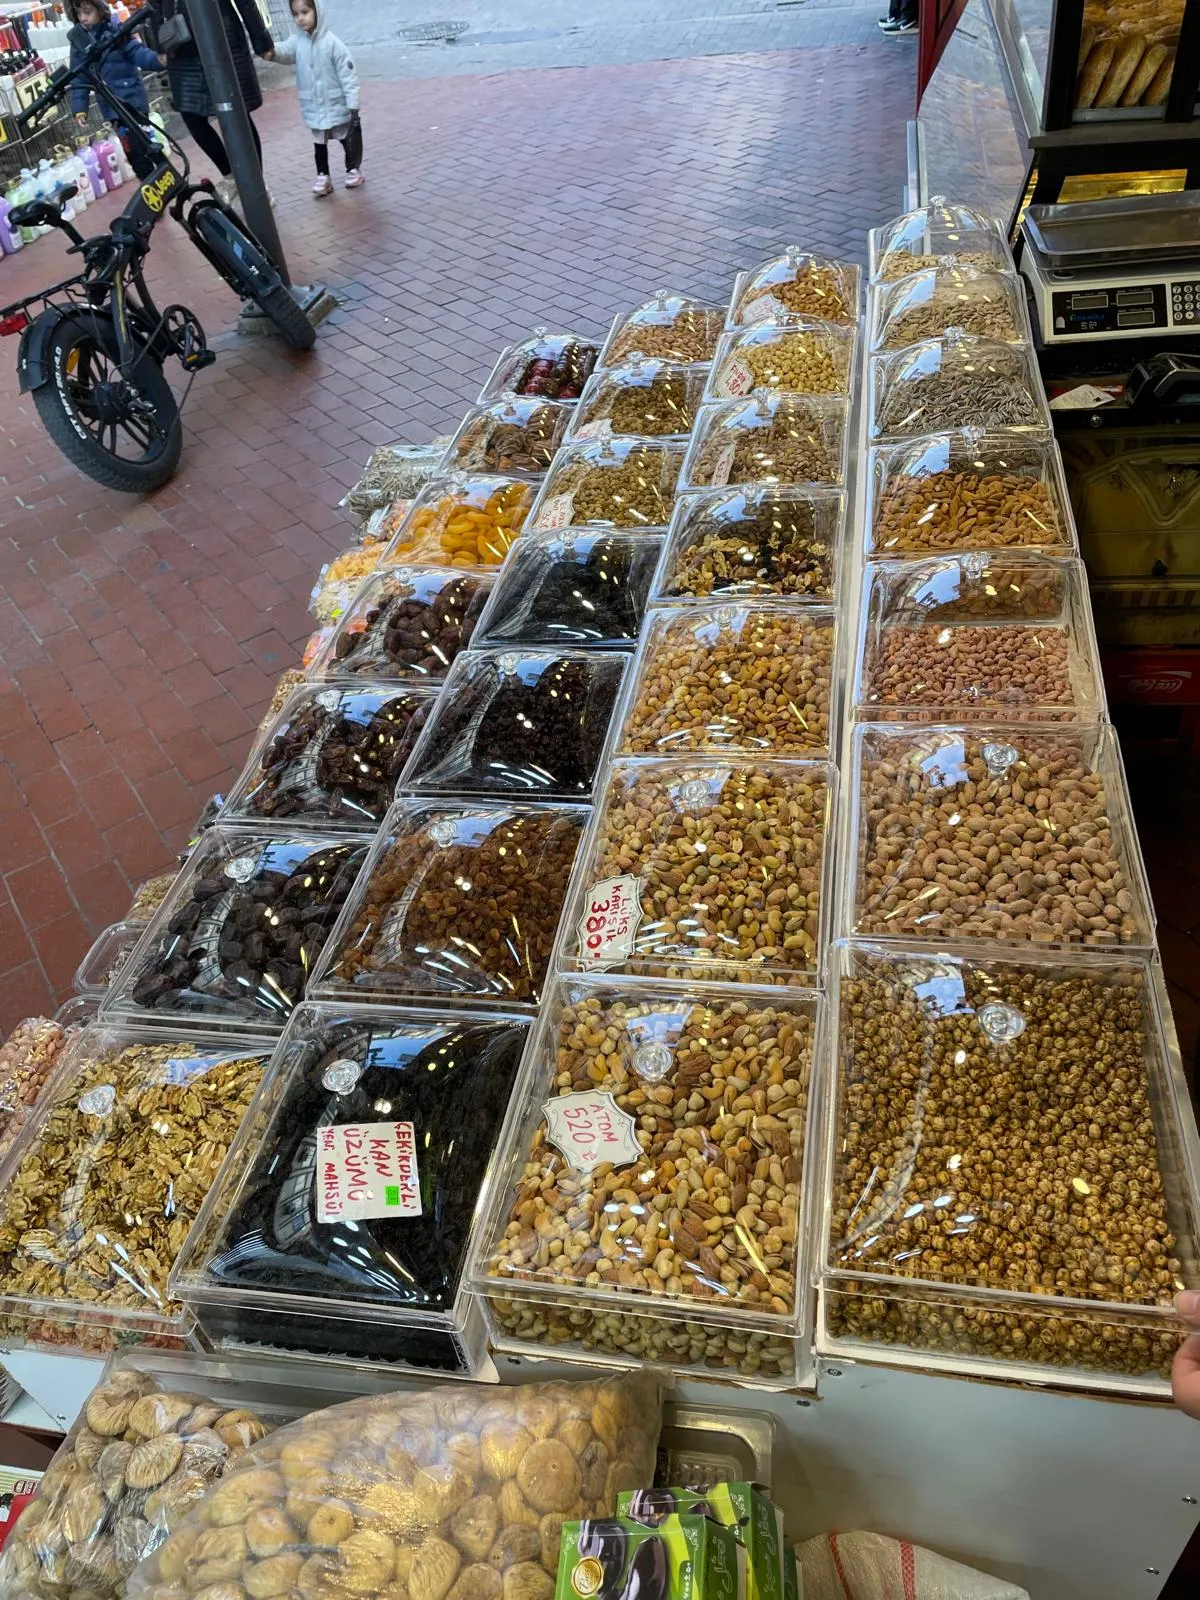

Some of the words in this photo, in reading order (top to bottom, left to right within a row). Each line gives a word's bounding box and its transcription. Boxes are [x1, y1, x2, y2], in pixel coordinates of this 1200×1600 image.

[155, 171, 175, 195] Jeep
[563, 1107, 597, 1144] 520
[589, 1102, 619, 1144] ATOM
[369, 1139, 393, 1177] KAN
